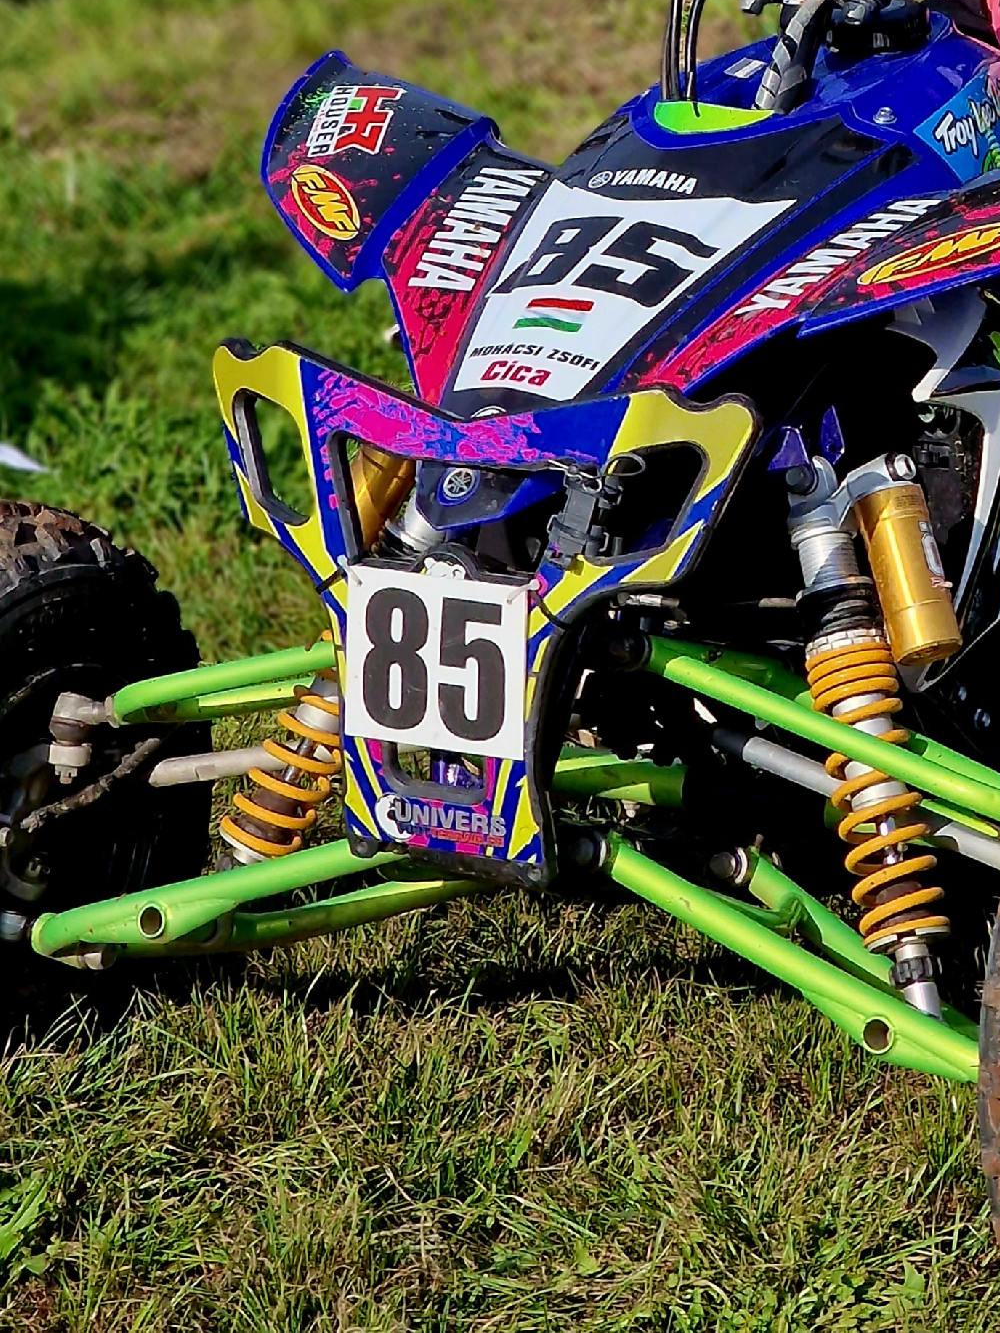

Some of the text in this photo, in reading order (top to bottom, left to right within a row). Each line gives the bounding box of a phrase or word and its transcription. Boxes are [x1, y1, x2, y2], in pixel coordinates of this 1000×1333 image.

[311, 86, 354, 156] HOUSER
[935, 112, 978, 156] Troy
[292, 170, 359, 233] FMF
[609, 168, 698, 195] YAMAHA
[408, 167, 545, 292] YAMAHA
[491, 216, 721, 308] 85
[734, 197, 942, 319] YAMAHA
[480, 360, 552, 386] Cica
[363, 586, 506, 742] 85
[395, 798, 507, 837] UNIVERS
